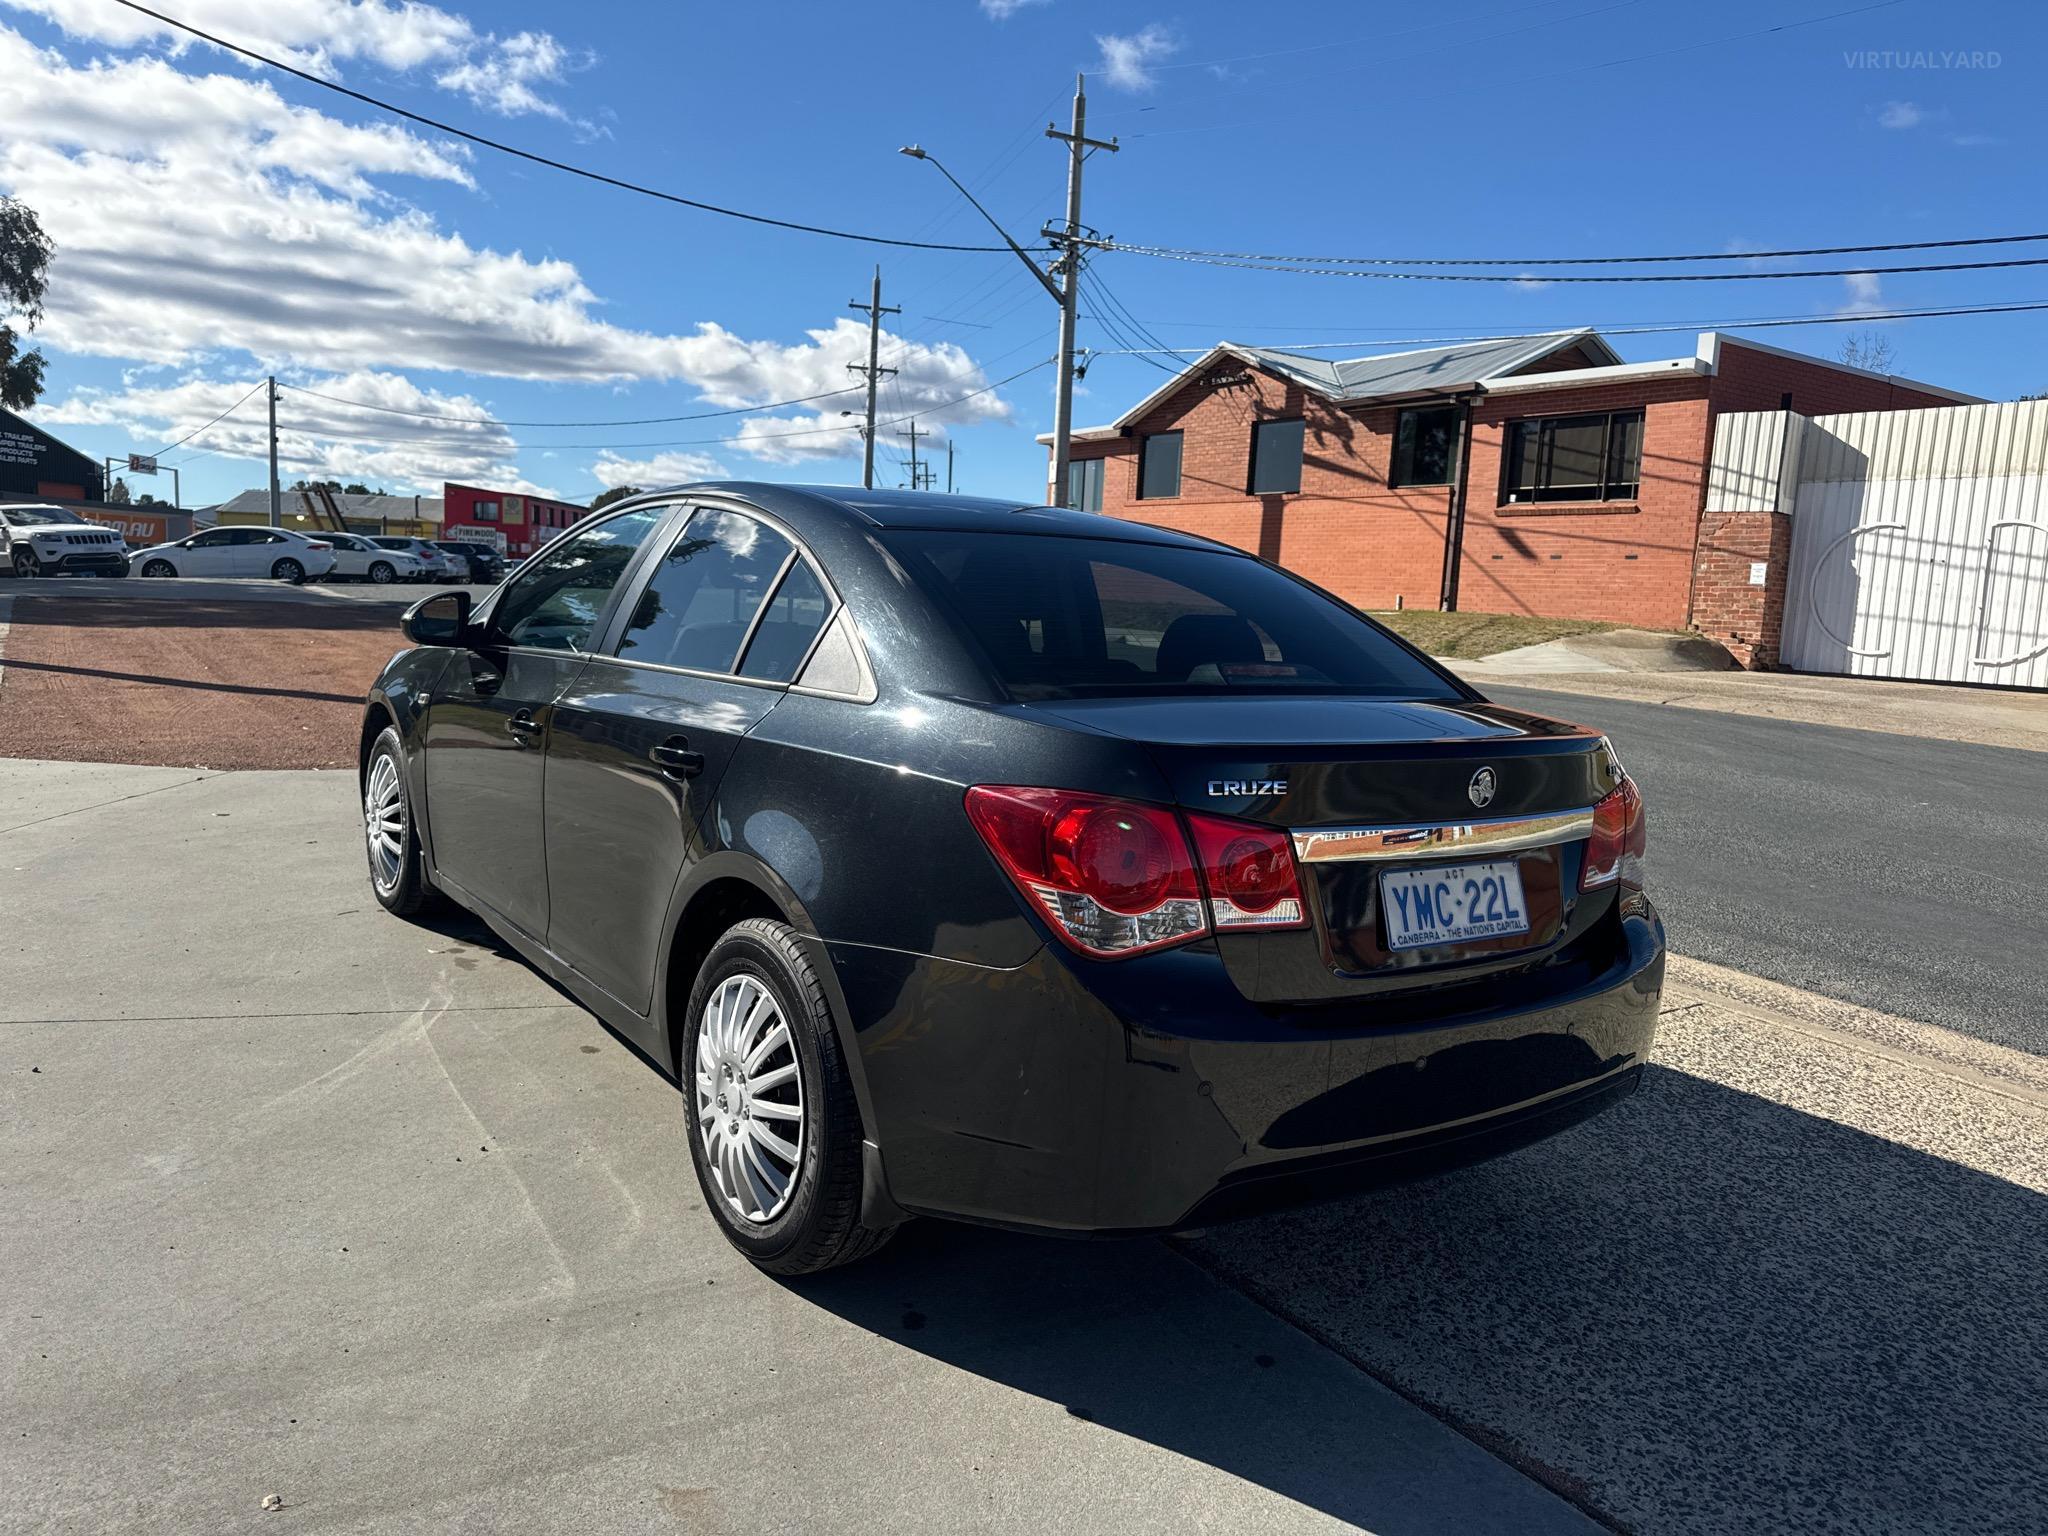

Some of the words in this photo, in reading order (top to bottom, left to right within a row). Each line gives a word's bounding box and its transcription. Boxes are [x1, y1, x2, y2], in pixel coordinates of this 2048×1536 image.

[3, 432, 34, 442] TRAILERS
[17, 442, 47, 452] TRAILERS
[459, 528, 495, 537] FIREWOOD
[1208, 781, 1287, 795] CRUZE
[1445, 869, 1464, 879] ACT
[1397, 931, 1440, 945] CANBERRA
[1447, 928, 1462, 938] THE
[1496, 920, 1523, 932] CAPITAL
